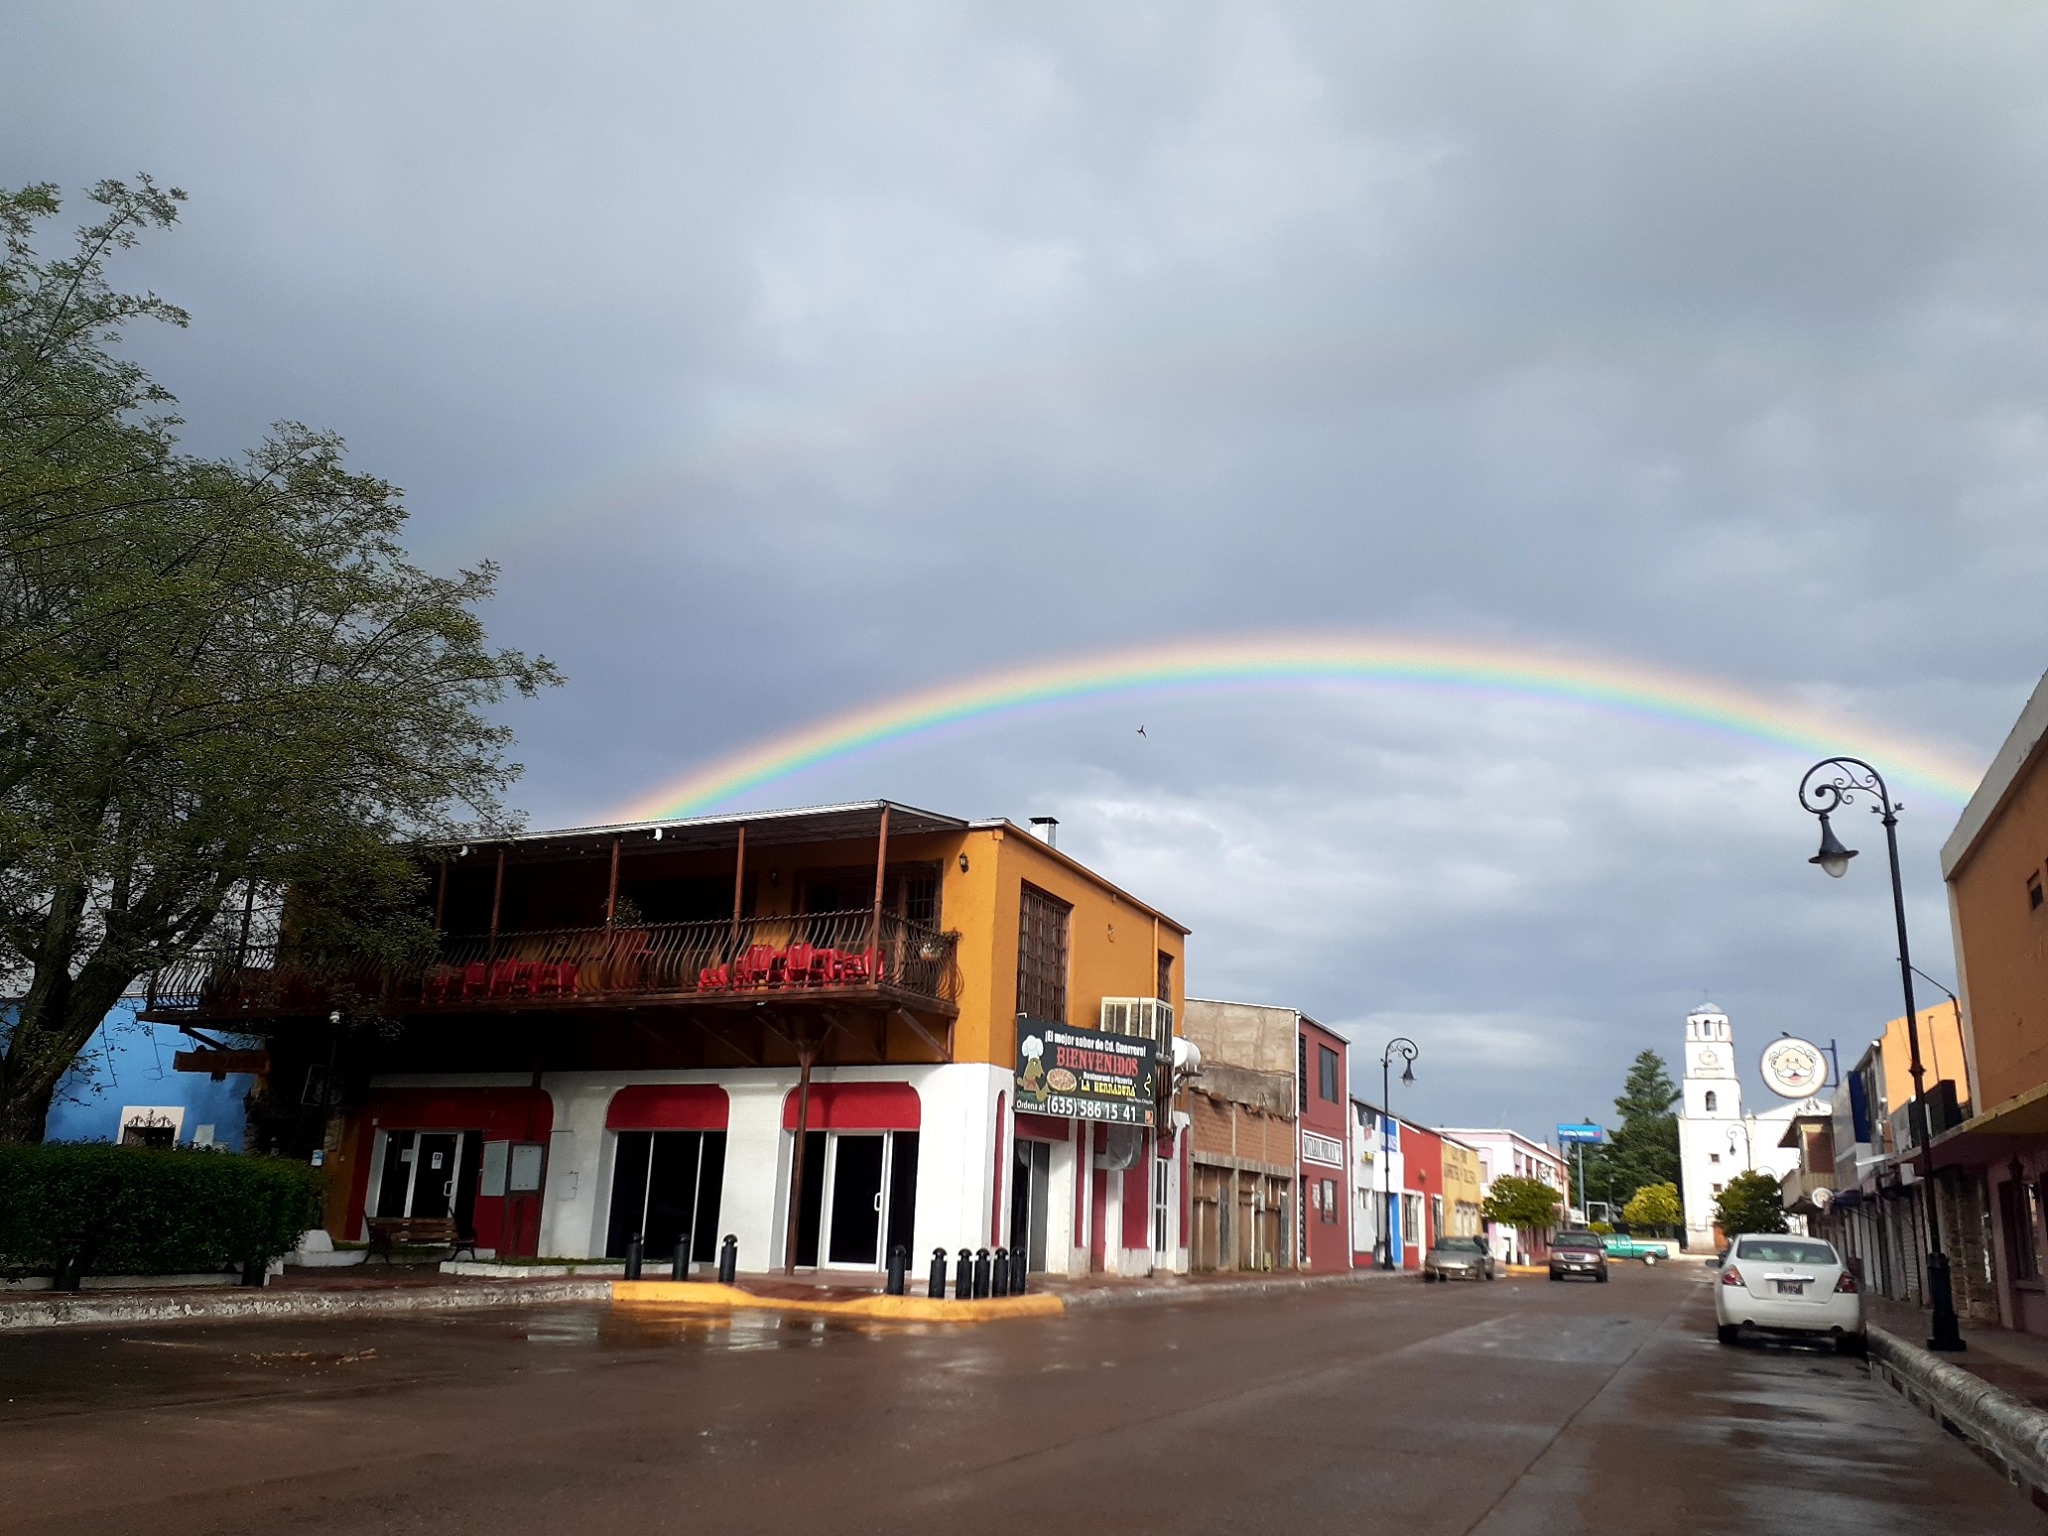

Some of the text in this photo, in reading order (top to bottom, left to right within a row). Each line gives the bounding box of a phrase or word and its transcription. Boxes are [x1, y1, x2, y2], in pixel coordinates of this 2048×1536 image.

[1054, 1032, 1075, 1046] mejor
[1075, 1036, 1094, 1050] sabor
[1095, 1038, 1104, 1051] de
[1104, 1040, 1115, 1052] Cd.
[1115, 1042, 1147, 1057] Guerrero!
[1056, 1046, 1139, 1077] BIENVENIDOS
[1016, 1099, 1038, 1111] Ordena
[1047, 1094, 1077, 1118] (635)
[1080, 1102, 1101, 1118] 586
[1105, 1103, 1118, 1120] 15
[1122, 1105, 1136, 1122] 41
